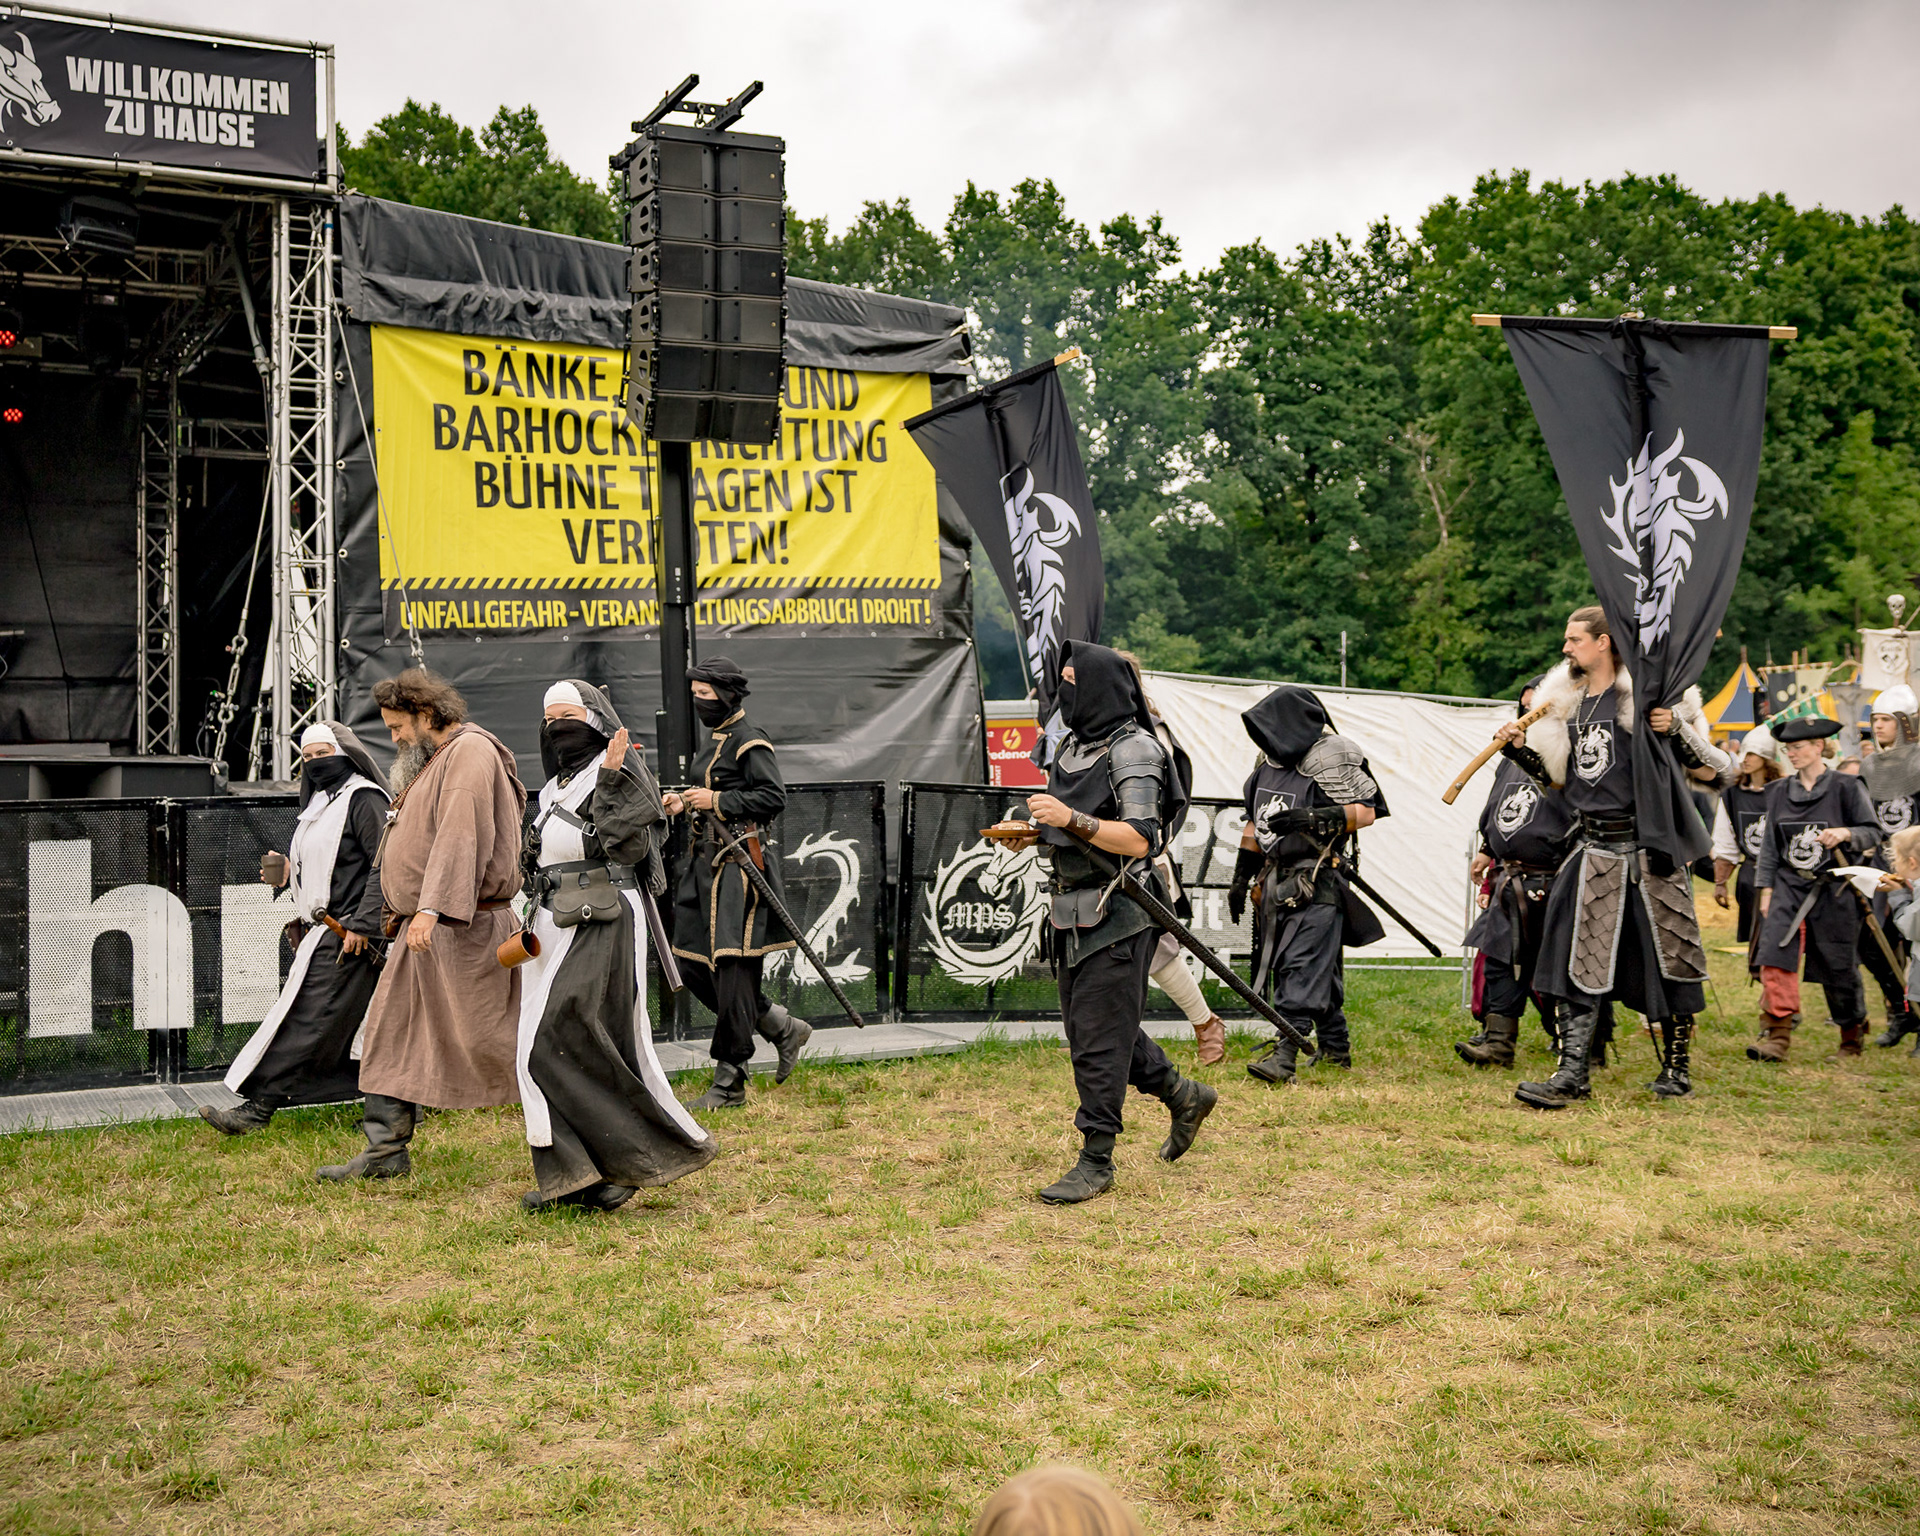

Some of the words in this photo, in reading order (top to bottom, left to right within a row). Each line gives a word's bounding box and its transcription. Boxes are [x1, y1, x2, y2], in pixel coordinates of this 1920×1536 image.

[66, 56, 290, 116] WILLKOMMEN
[105, 99, 146, 136] ZU
[154, 105, 255, 148] HAUSE
[462, 344, 620, 407] BÄNKE,
[784, 367, 859, 411] UND
[433, 403, 658, 457] BARHOCK
[474, 454, 619, 510] BÜHNE
[629, 464, 793, 512] TAGEN
[803, 468, 857, 513] IST
[562, 518, 790, 566] VERTEN!
[863, 598, 931, 625] DROHT!
[1168, 805, 1249, 867] PS
[941, 901, 1017, 934] MPS
